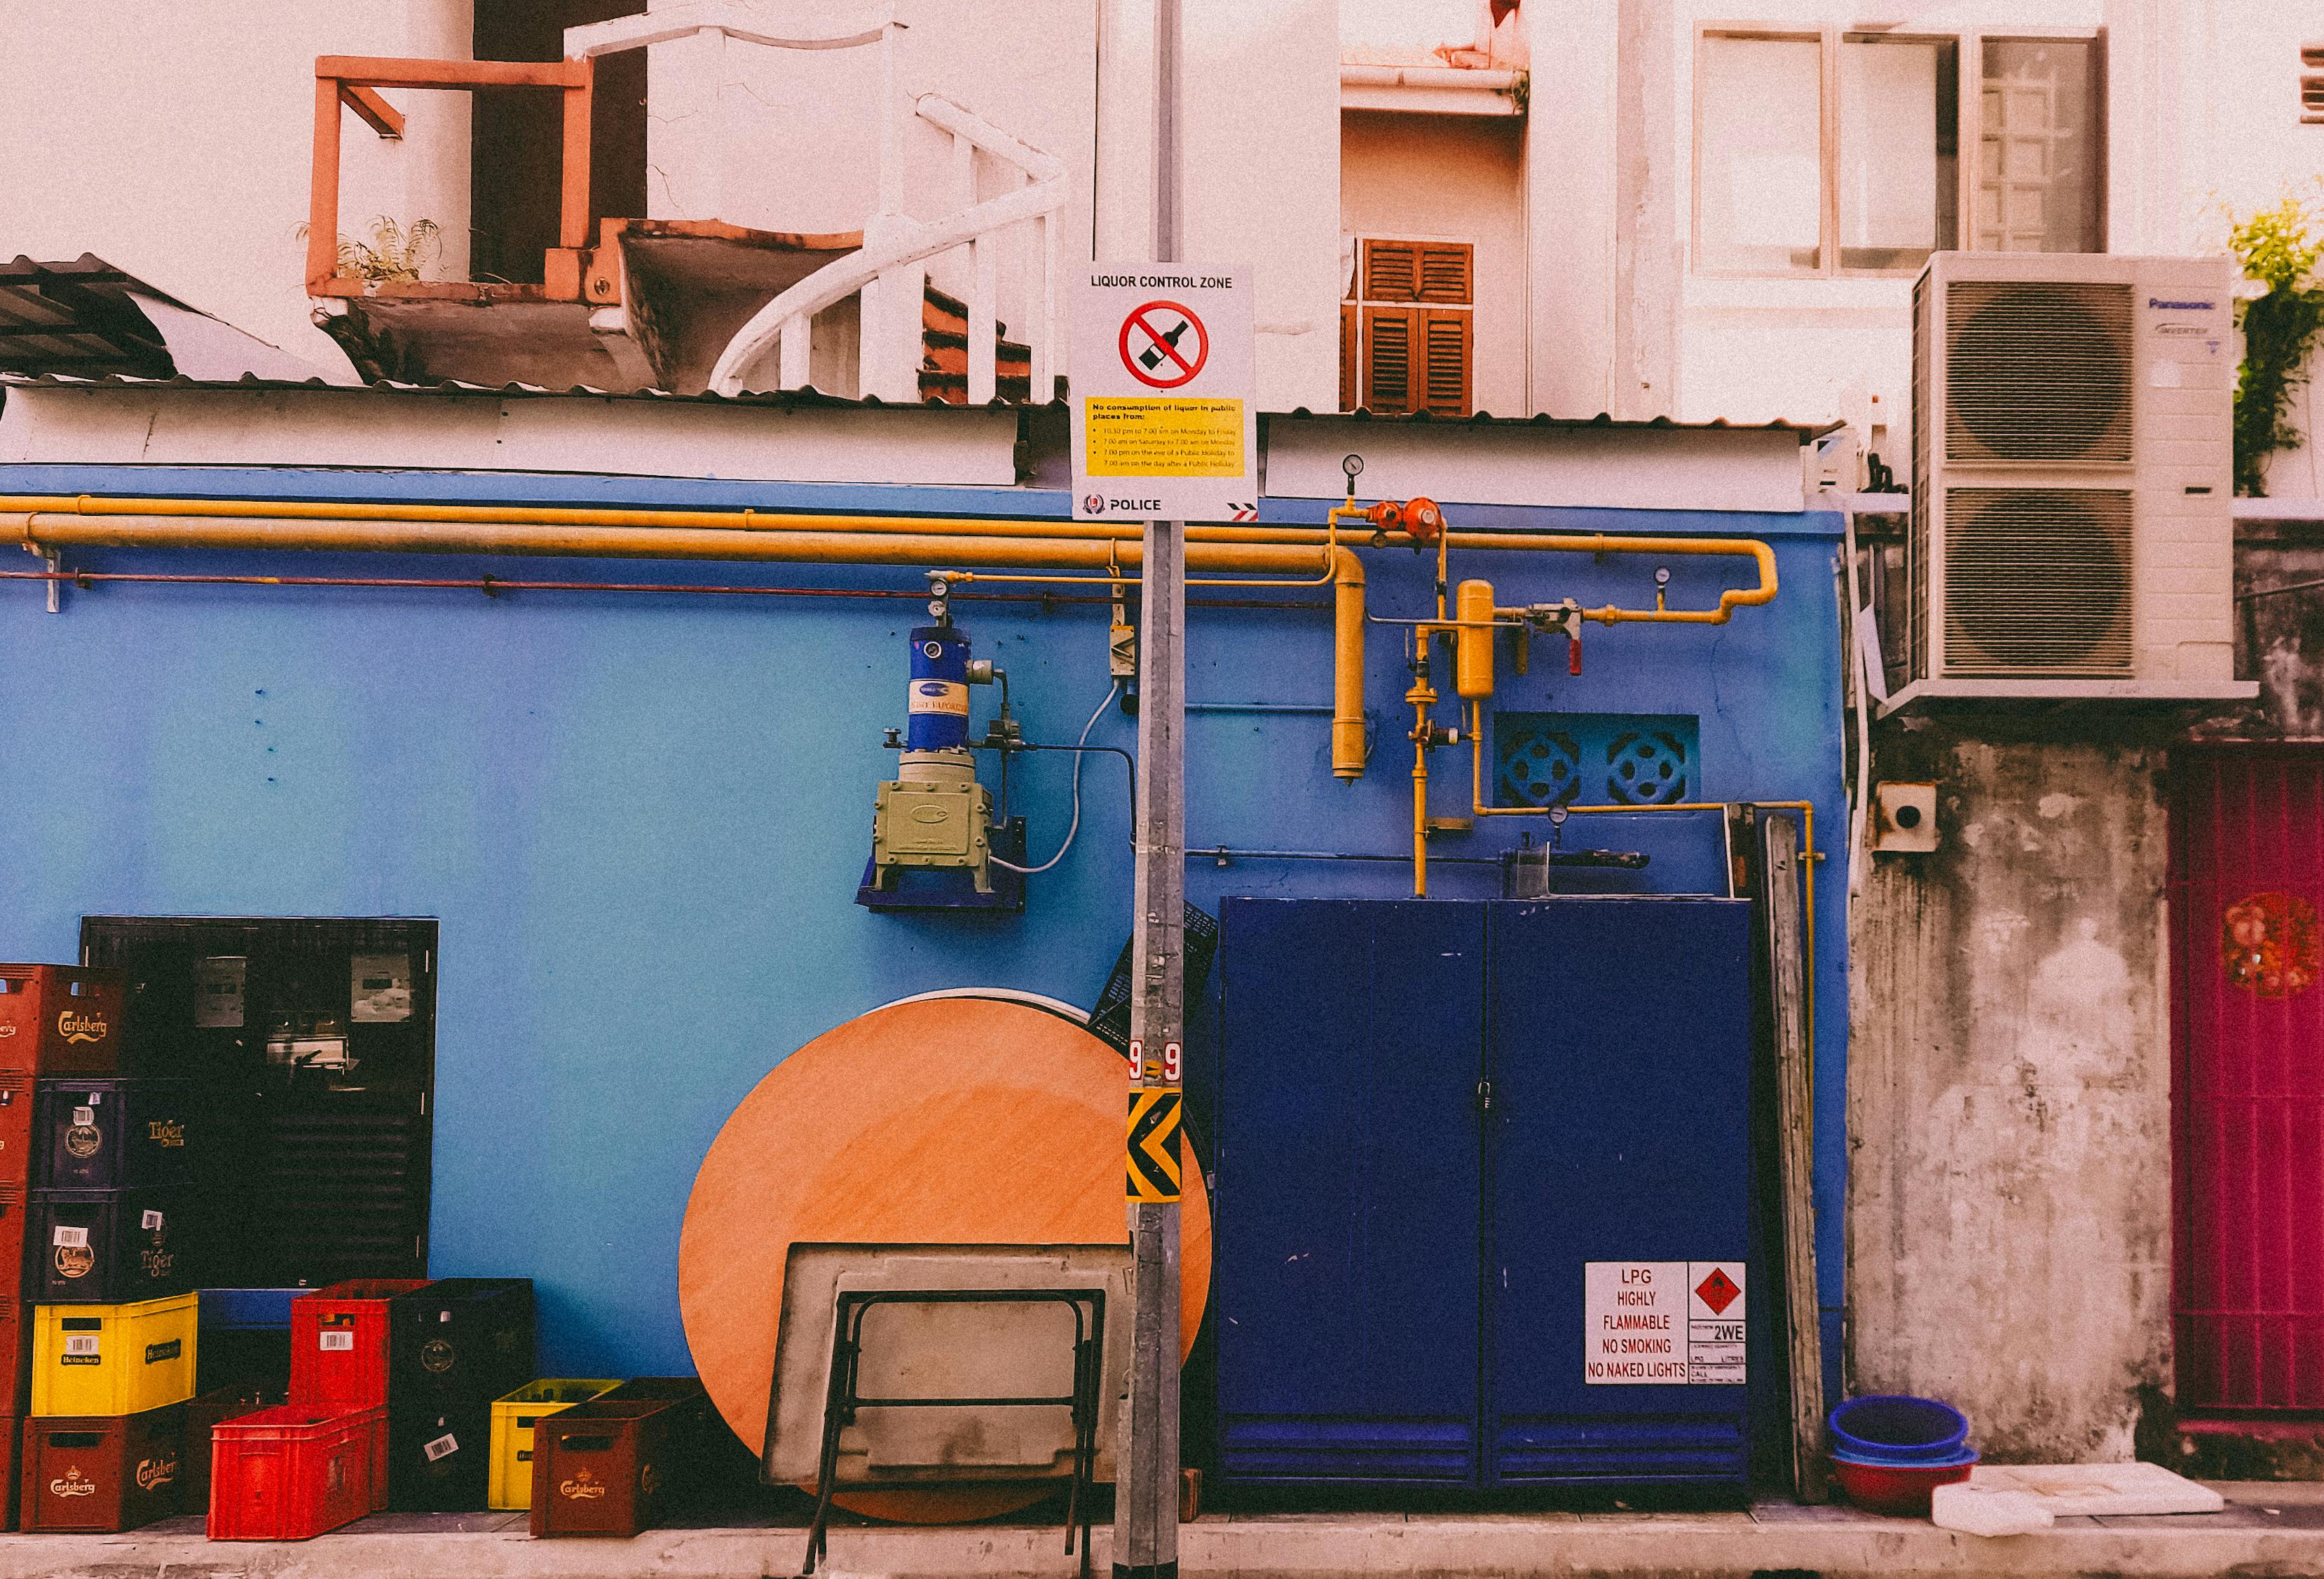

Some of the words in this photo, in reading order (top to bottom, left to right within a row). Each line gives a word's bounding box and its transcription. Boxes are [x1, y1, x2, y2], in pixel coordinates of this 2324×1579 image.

[1091, 275, 1137, 287] LIQUOR
[1140, 276, 1197, 287] CONTROL
[1201, 277, 1232, 288] ZONE
[2149, 298, 2215, 309] Panasonic
[1110, 499, 1161, 510] POLICE
[58, 1011, 107, 1038] Carlsberg
[1130, 1041, 1142, 1079] 9
[1165, 1043, 1180, 1081] 9
[148, 1120, 184, 1147] Tiger
[141, 1249, 174, 1277] Tiger
[1621, 1269, 1651, 1284] LPG
[1618, 1292, 1656, 1306] HIGHLY
[1604, 1315, 1670, 1329] FLAMMABLE
[1714, 1325, 1743, 1340] 2WE
[1603, 1339, 1618, 1353] NO
[1621, 1339, 1671, 1354] SMOKING
[1588, 1362, 1604, 1377] NO
[1607, 1362, 1644, 1377] NAKED
[1648, 1362, 1686, 1377] LIGHTS
[50, 1479, 95, 1494] Carlsberg
[560, 1480, 606, 1496] Carlsberg
